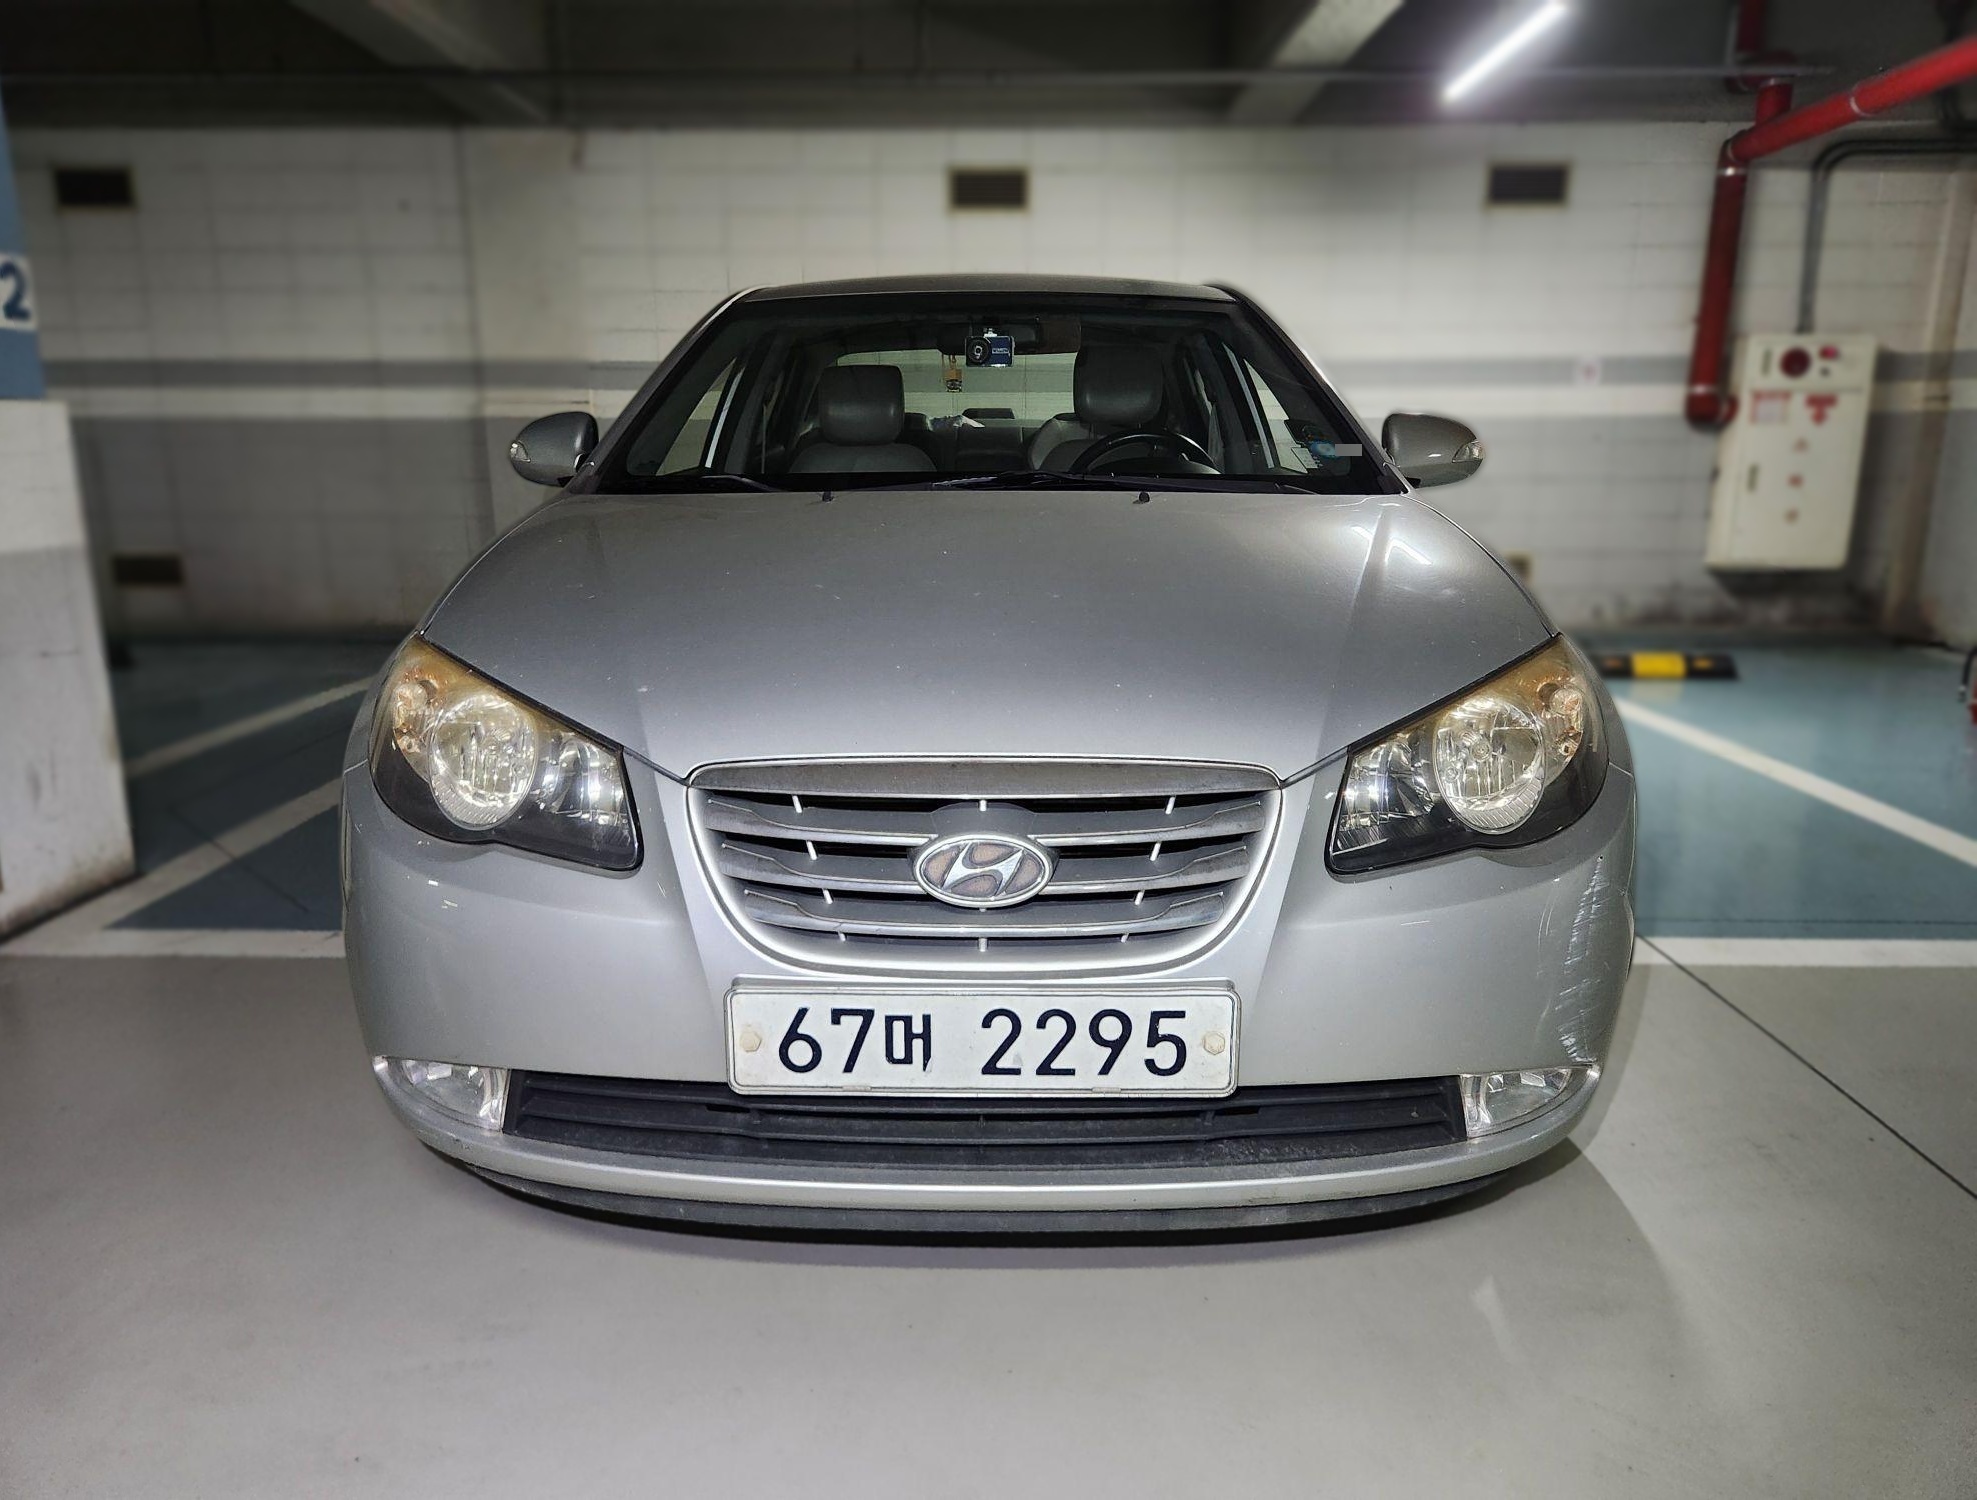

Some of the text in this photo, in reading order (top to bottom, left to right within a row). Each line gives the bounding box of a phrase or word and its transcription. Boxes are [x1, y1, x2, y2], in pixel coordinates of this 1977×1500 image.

[0, 261, 31, 321] 2
[779, 1007, 1187, 1076] 67머 2295
